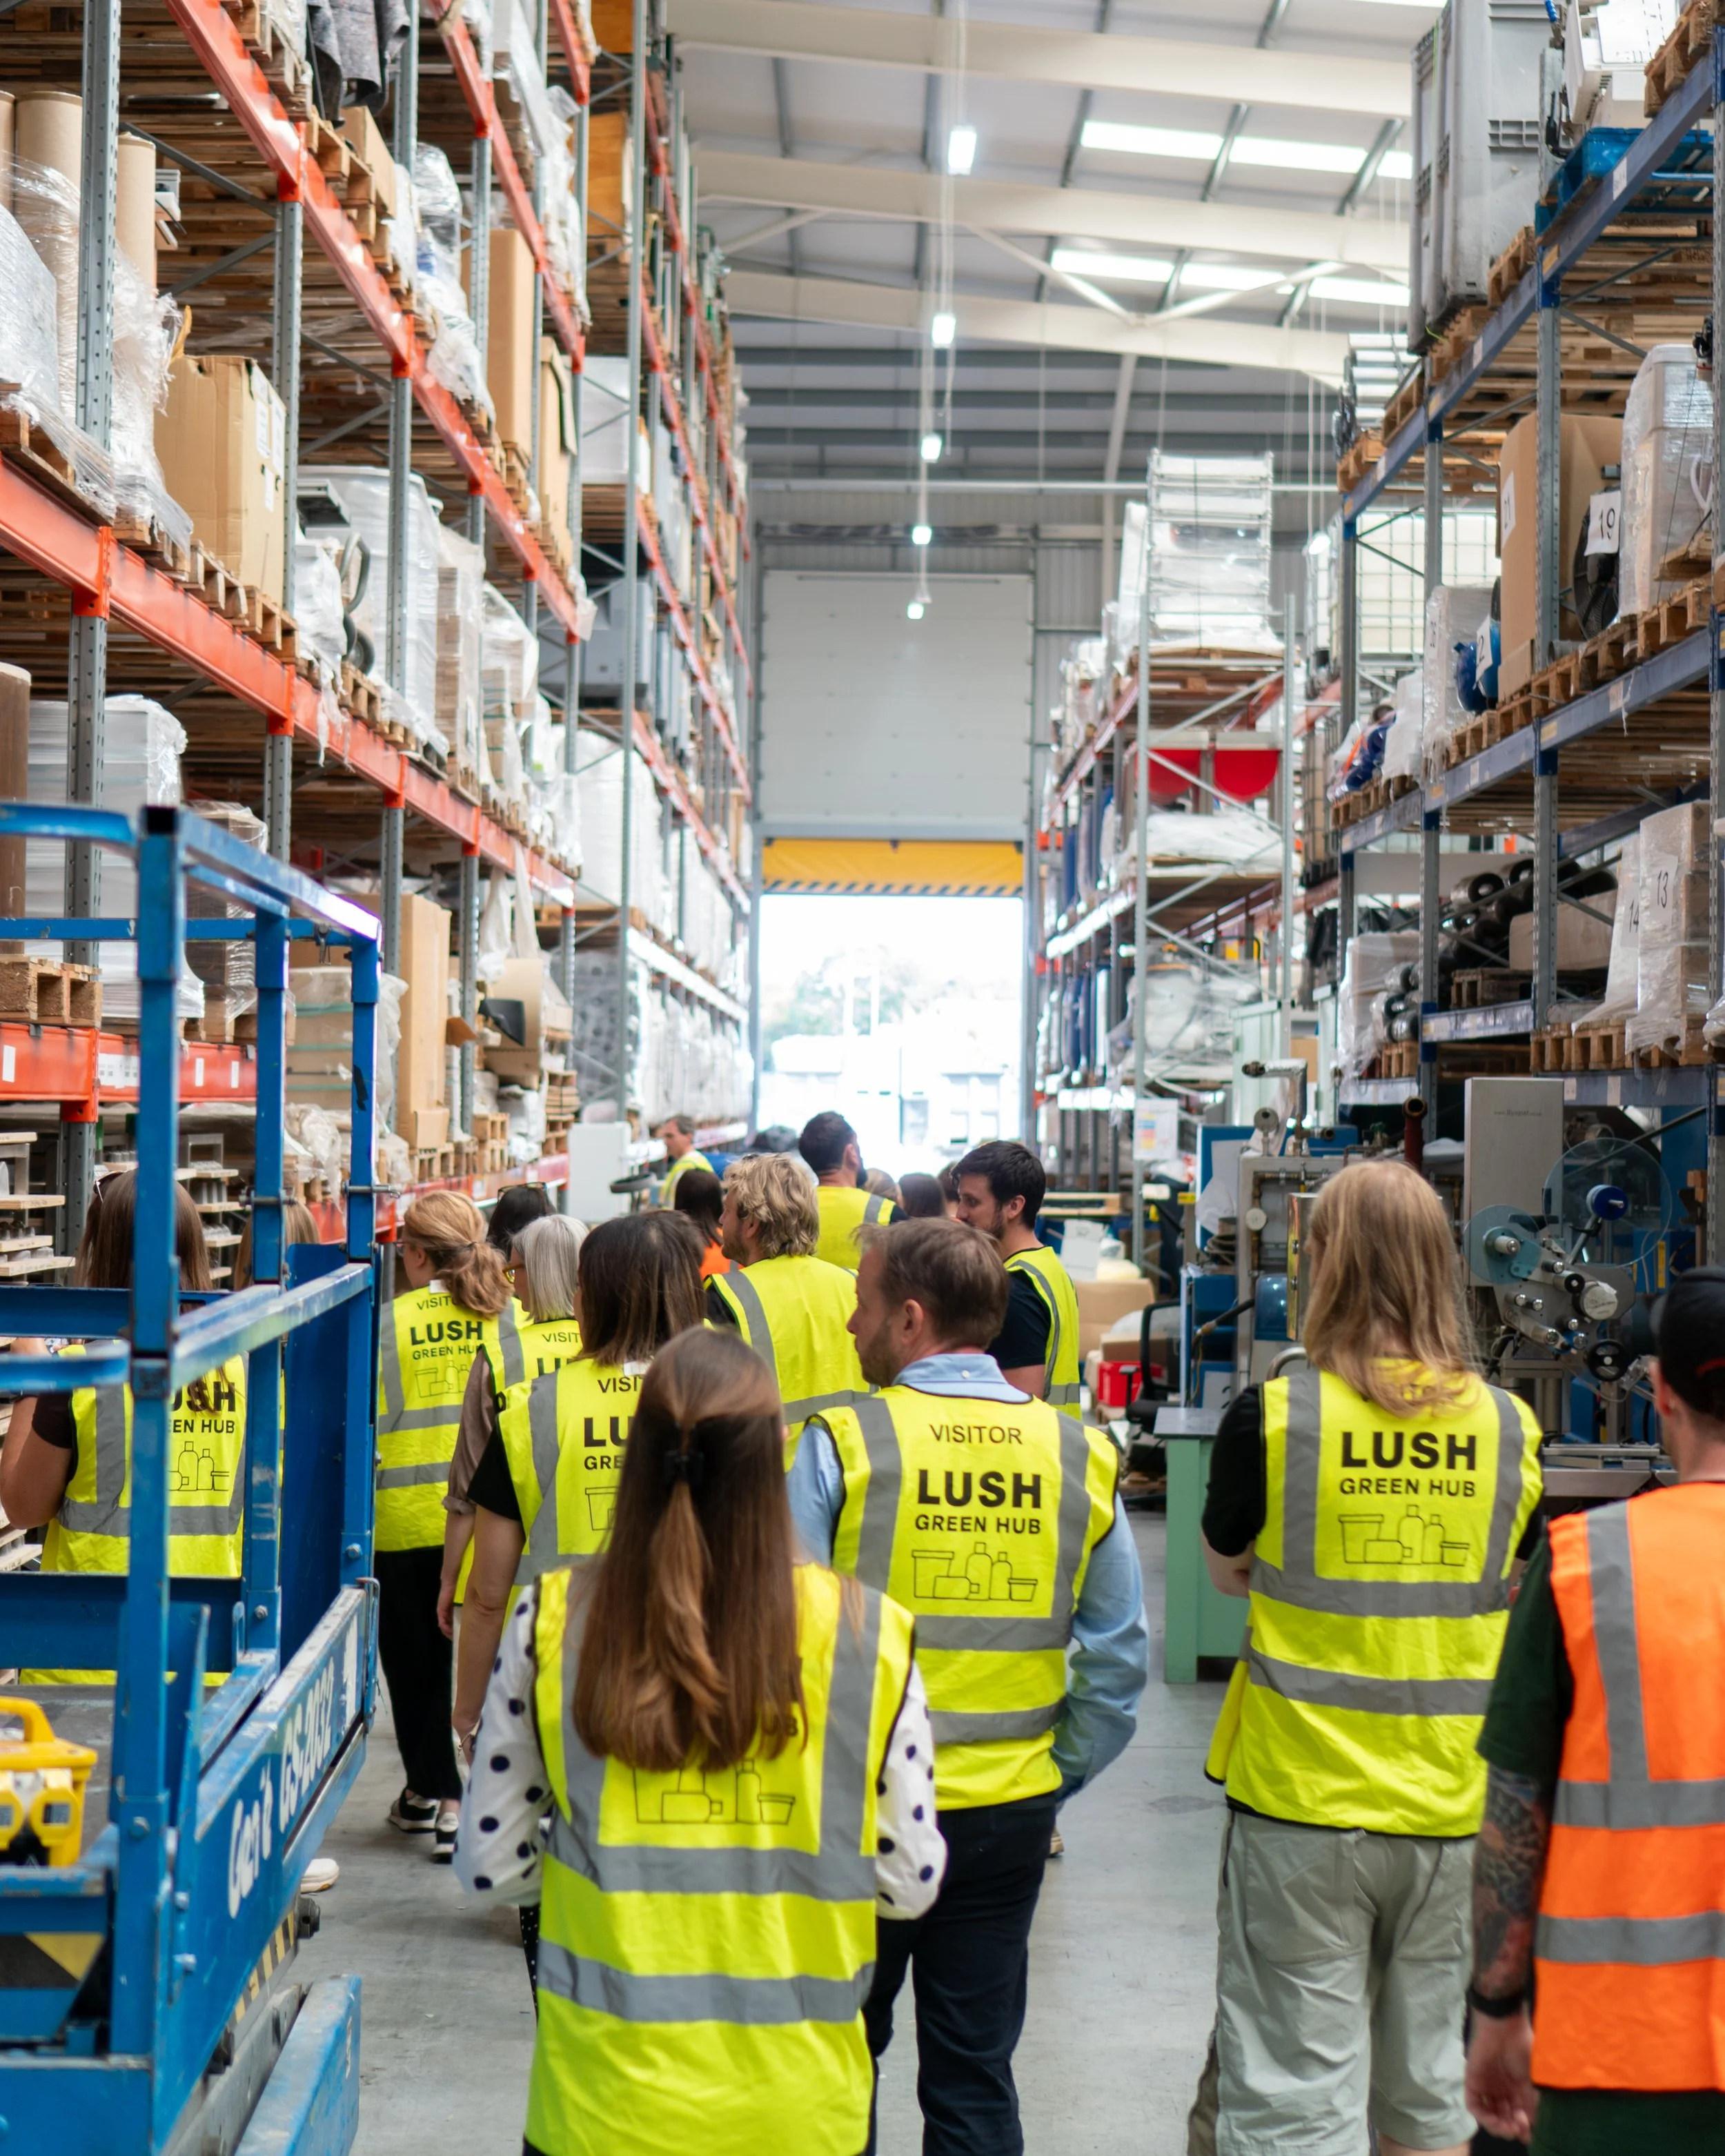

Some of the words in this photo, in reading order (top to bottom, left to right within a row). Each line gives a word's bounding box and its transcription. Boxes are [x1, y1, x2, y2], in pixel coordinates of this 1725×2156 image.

[1598, 508, 1615, 540] 19
[1657, 870, 1668, 909] 13
[1629, 899, 1639, 933] 14
[417, 1295, 457, 1311] VISIT
[410, 1320, 483, 1345] LUSH
[542, 1332, 580, 1343] VISIT
[413, 1346, 453, 1360] GREEN
[598, 1376, 643, 1393] VISI
[201, 1419, 235, 1434] HUB
[584, 1416, 634, 1447] LU
[929, 1424, 1023, 1445] VISITOR
[1341, 1432, 1477, 1471] LUSH
[584, 1455, 624, 1470] GRE
[918, 1469, 1041, 1509] LUSH
[1340, 1478, 1419, 1495] GREEN
[1429, 1479, 1476, 1497] HUB
[915, 1514, 987, 1532] GREEN
[996, 1518, 1041, 1534] HUB
